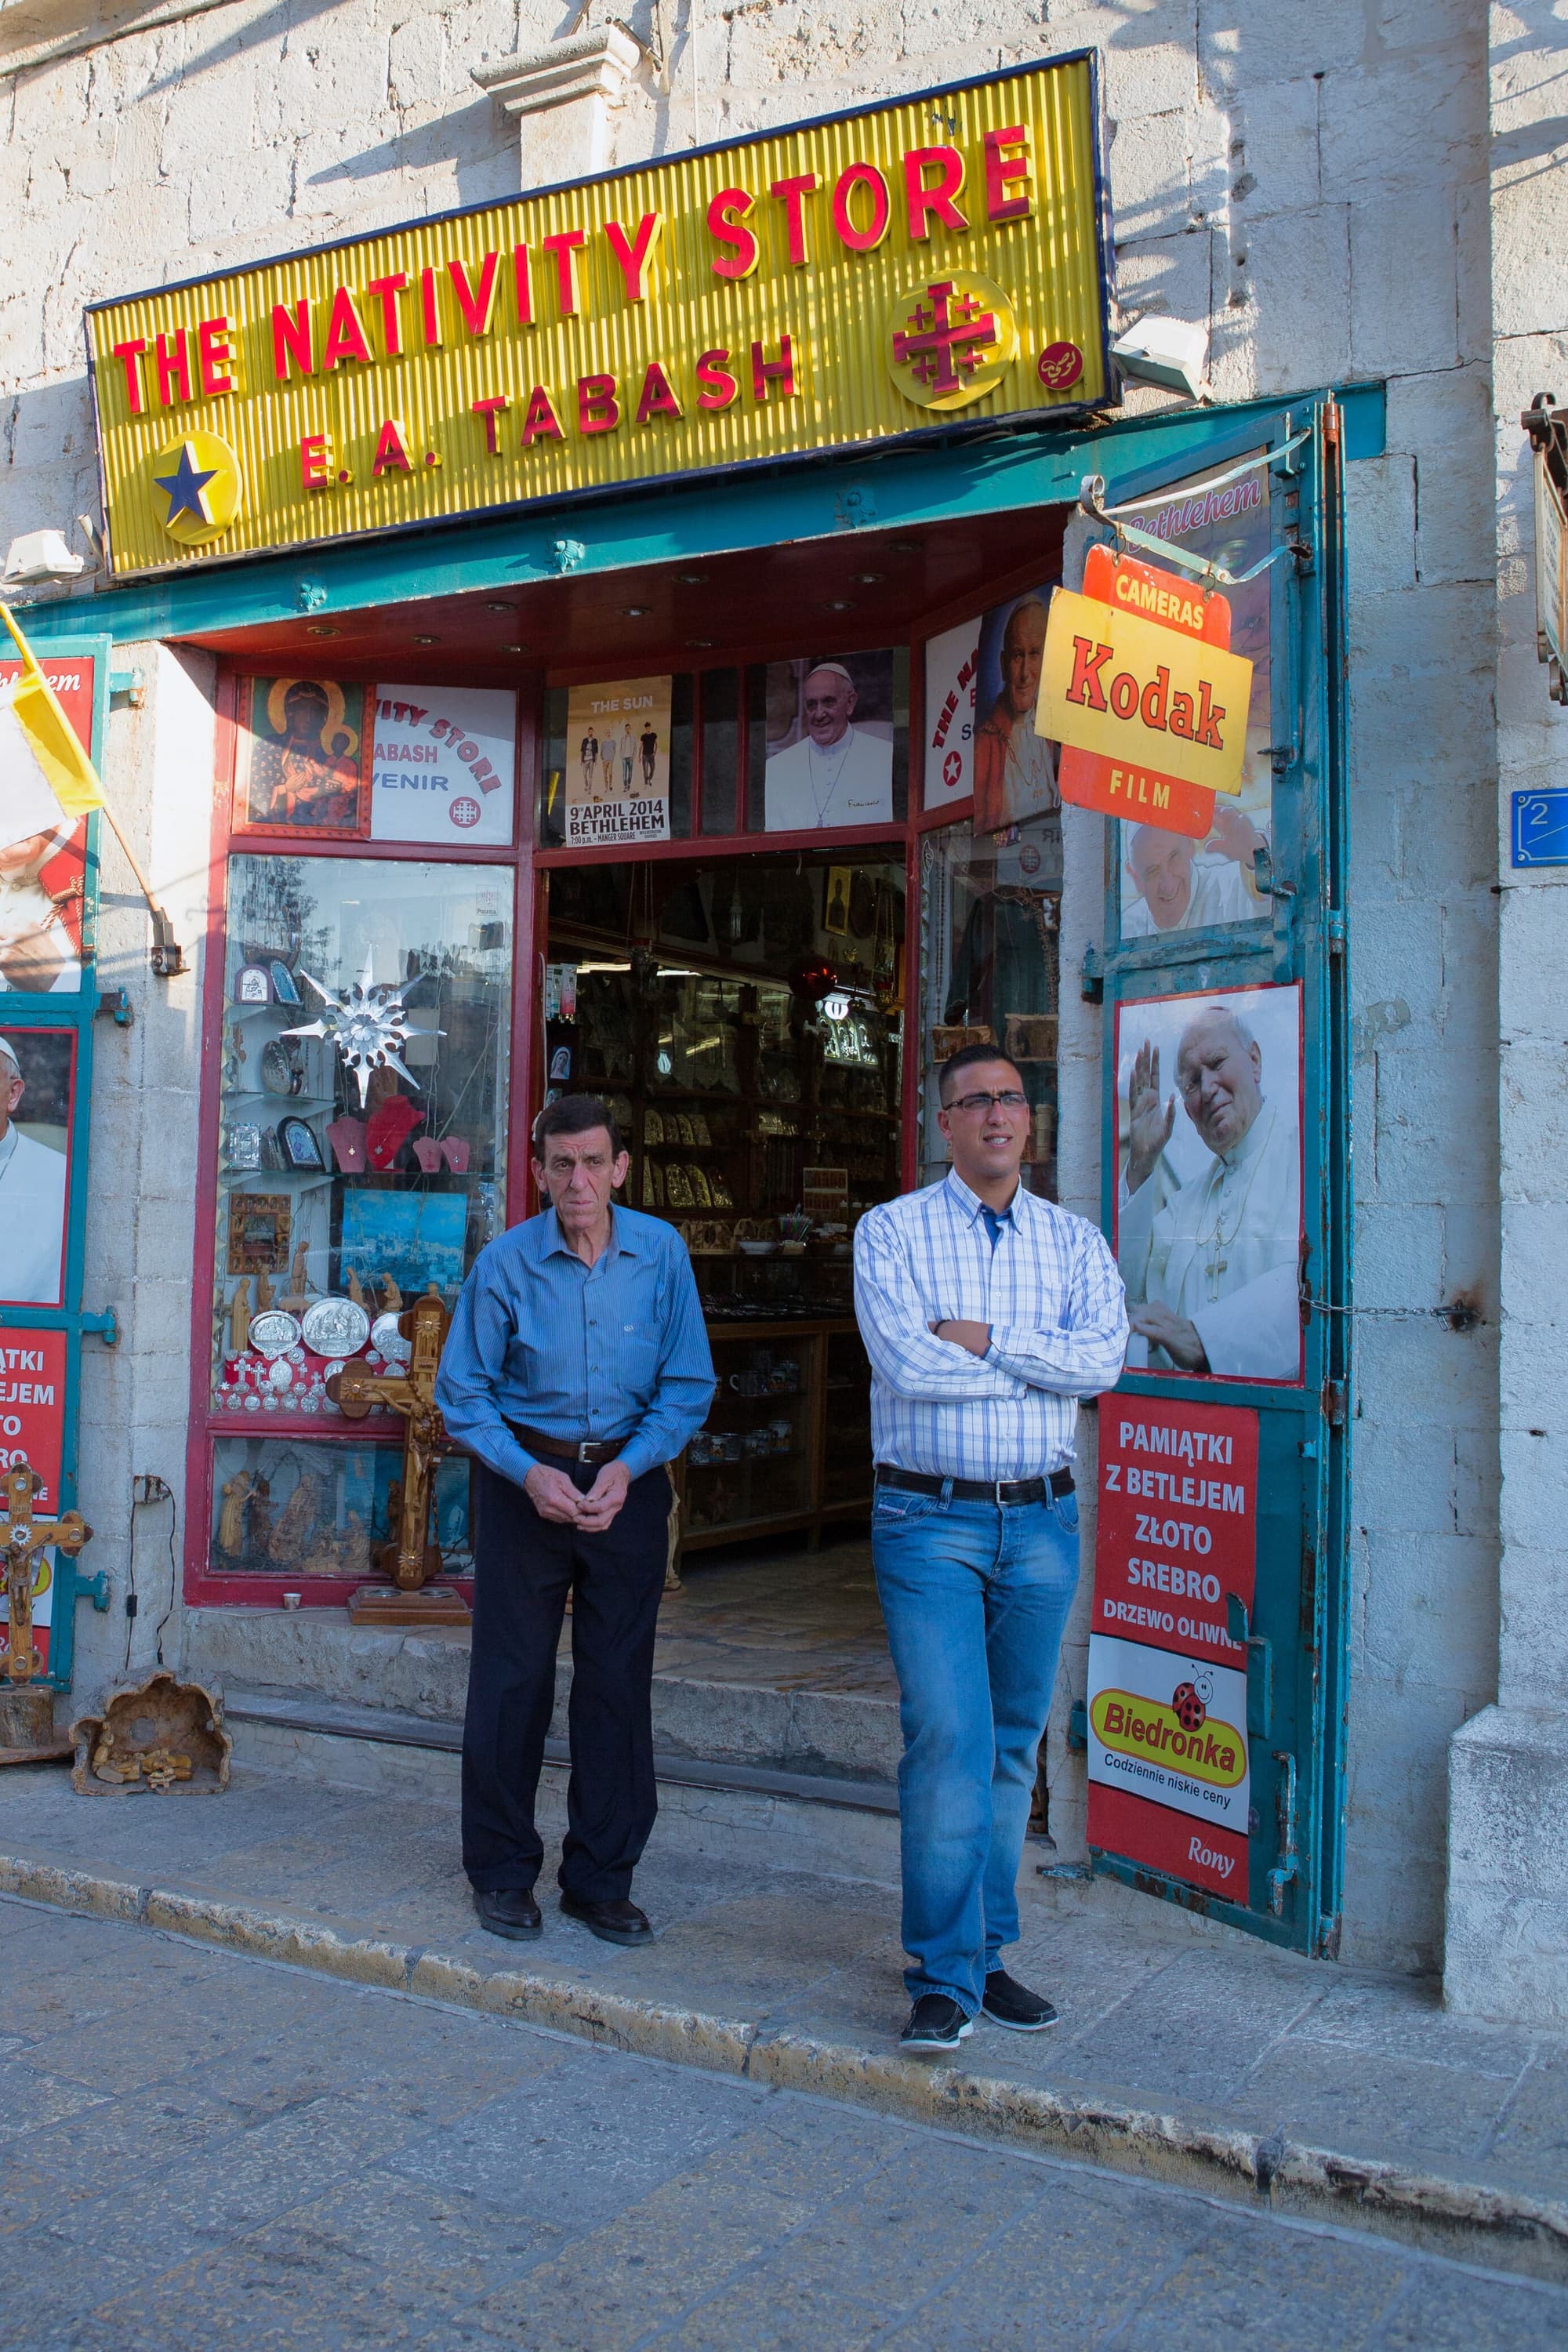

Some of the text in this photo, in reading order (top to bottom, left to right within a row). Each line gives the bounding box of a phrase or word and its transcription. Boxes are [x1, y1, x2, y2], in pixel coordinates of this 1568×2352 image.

[114, 124, 1034, 415] THE NATIVITY STORE
[473, 334, 799, 454] TABASH
[1116, 574, 1204, 630] CAMERAS
[591, 695, 653, 713] THE SUN
[1065, 635, 1226, 750] Kodak
[932, 689, 960, 749] THE
[428, 718, 503, 795] STORE
[583, 803, 625, 820] APRIL
[629, 800, 663, 816] 2014
[1109, 769, 1171, 810] FILM
[570, 815, 665, 837] BETHLEHEM
[597, 833, 617, 843] MANGER
[617, 831, 636, 841] SQUARE
[1530, 803, 1548, 825] 2
[1120, 1421, 1232, 1467] PAMIĄTKI
[1105, 1464, 1245, 1514] Z BETLEJEM
[1134, 1514, 1212, 1555] ZŁOTO
[1127, 1557, 1221, 1603] SREBRO
[1103, 1599, 1174, 1632] DRZEWO
[1103, 1703, 1236, 1773] Biedronka
[1104, 1753, 1231, 1809] Codziennie niskie ceny
[1188, 1837, 1236, 1879] Rony
